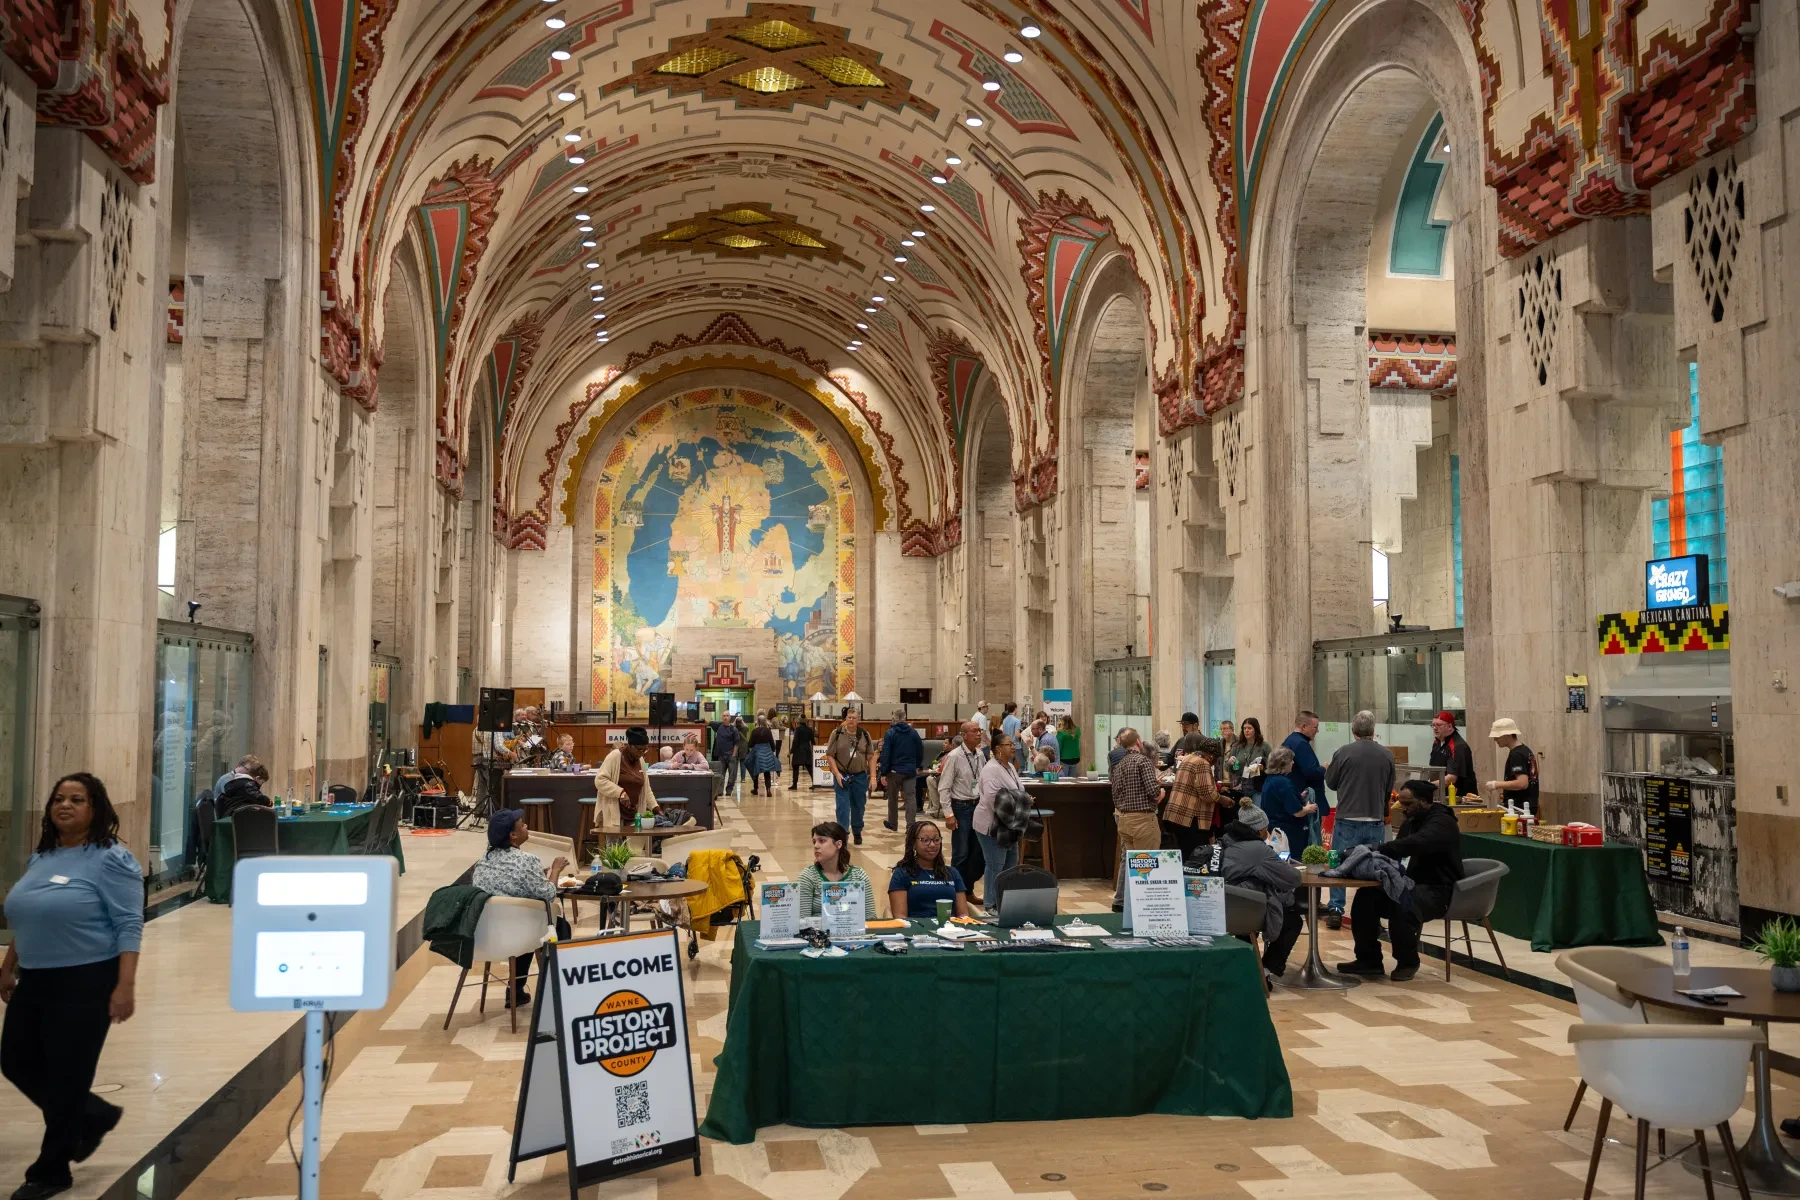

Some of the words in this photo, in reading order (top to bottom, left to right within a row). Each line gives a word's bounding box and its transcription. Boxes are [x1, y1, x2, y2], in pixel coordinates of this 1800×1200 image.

[1655, 570, 1688, 589] CRAZY
[1640, 609, 1673, 624] MEXICAN
[1675, 606, 1710, 621] CANTINA
[562, 954, 673, 986] WELCOME
[606, 998, 639, 1009] WAYNE
[579, 1007, 667, 1040] HISTORY
[581, 1026, 670, 1060] PROJECT
[610, 1056, 647, 1069] COUNTY
[612, 1149, 663, 1165] detroithistorical.org
